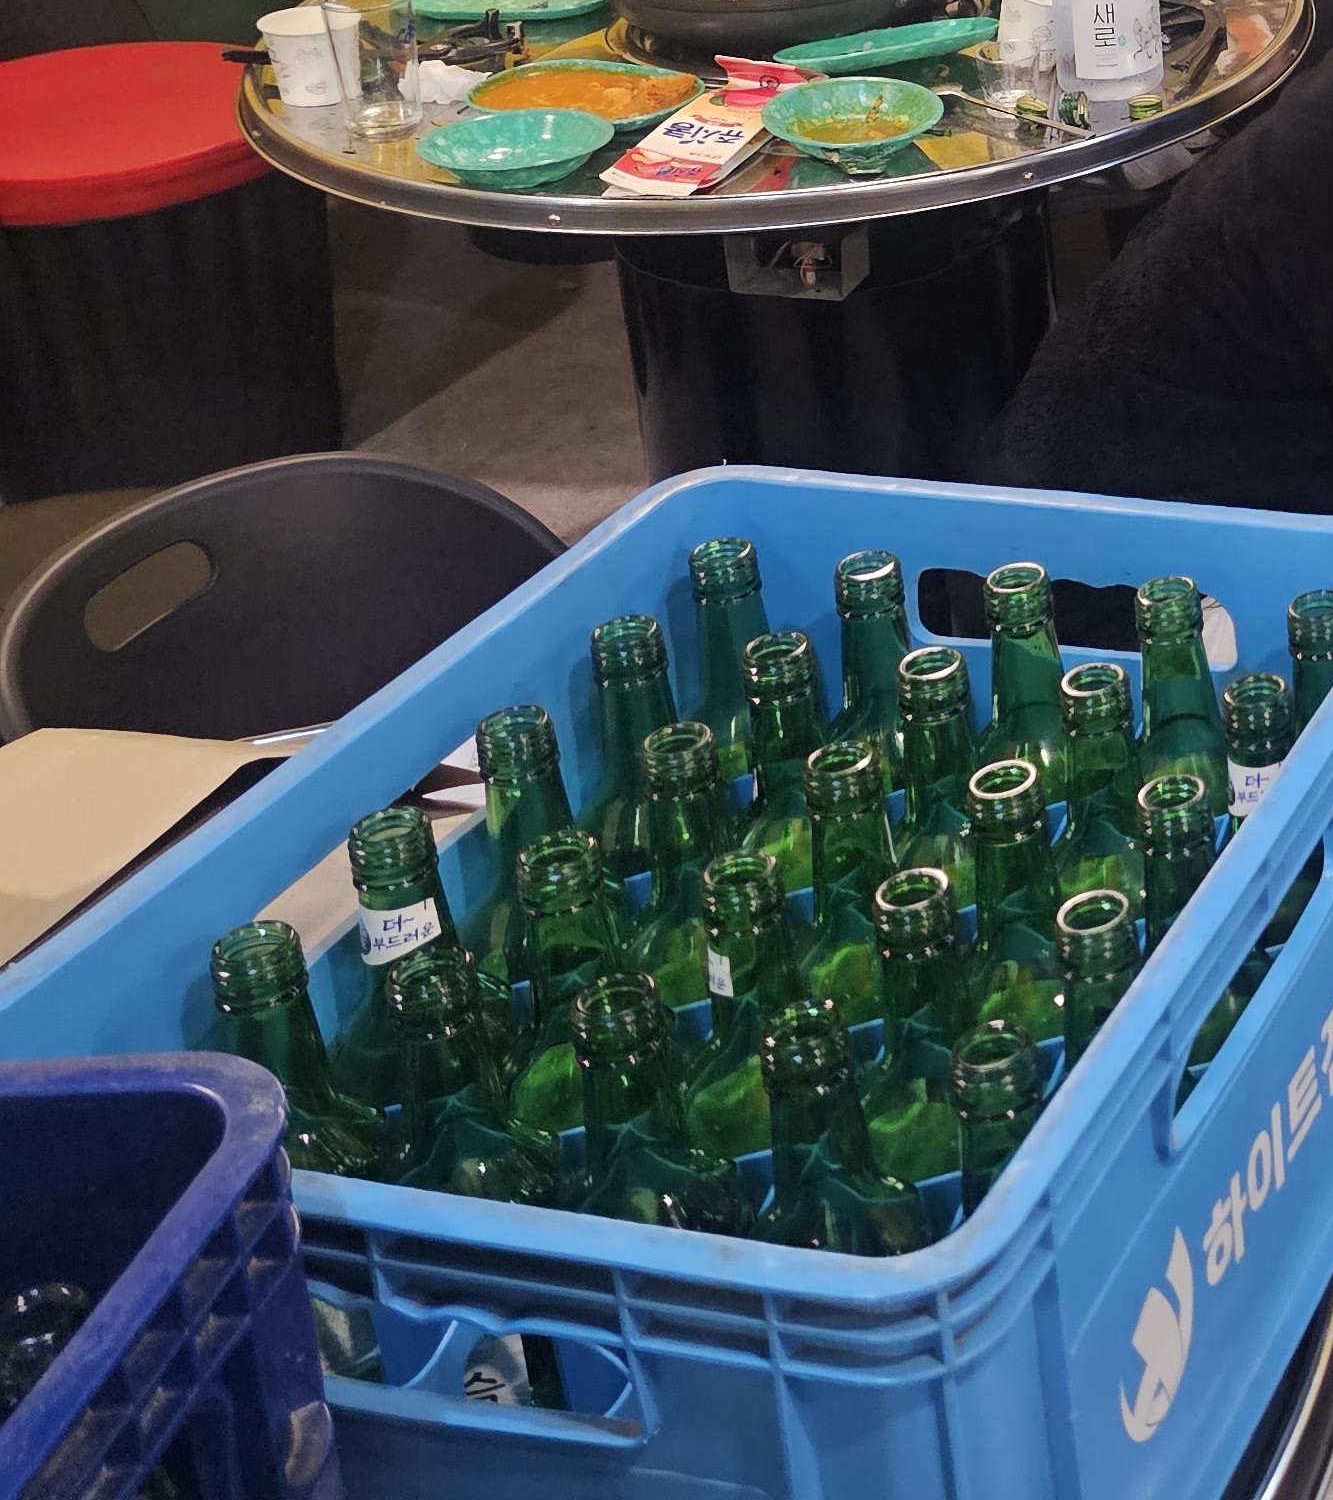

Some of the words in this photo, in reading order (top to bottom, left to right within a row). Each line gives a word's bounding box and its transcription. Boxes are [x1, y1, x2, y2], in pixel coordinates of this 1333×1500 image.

[1093, 2, 1117, 48] 새로
[662, 120, 746, 145] 쥬시쿨
[1237, 790, 1264, 804] 부드
[372, 921, 435, 951] 부드러운
